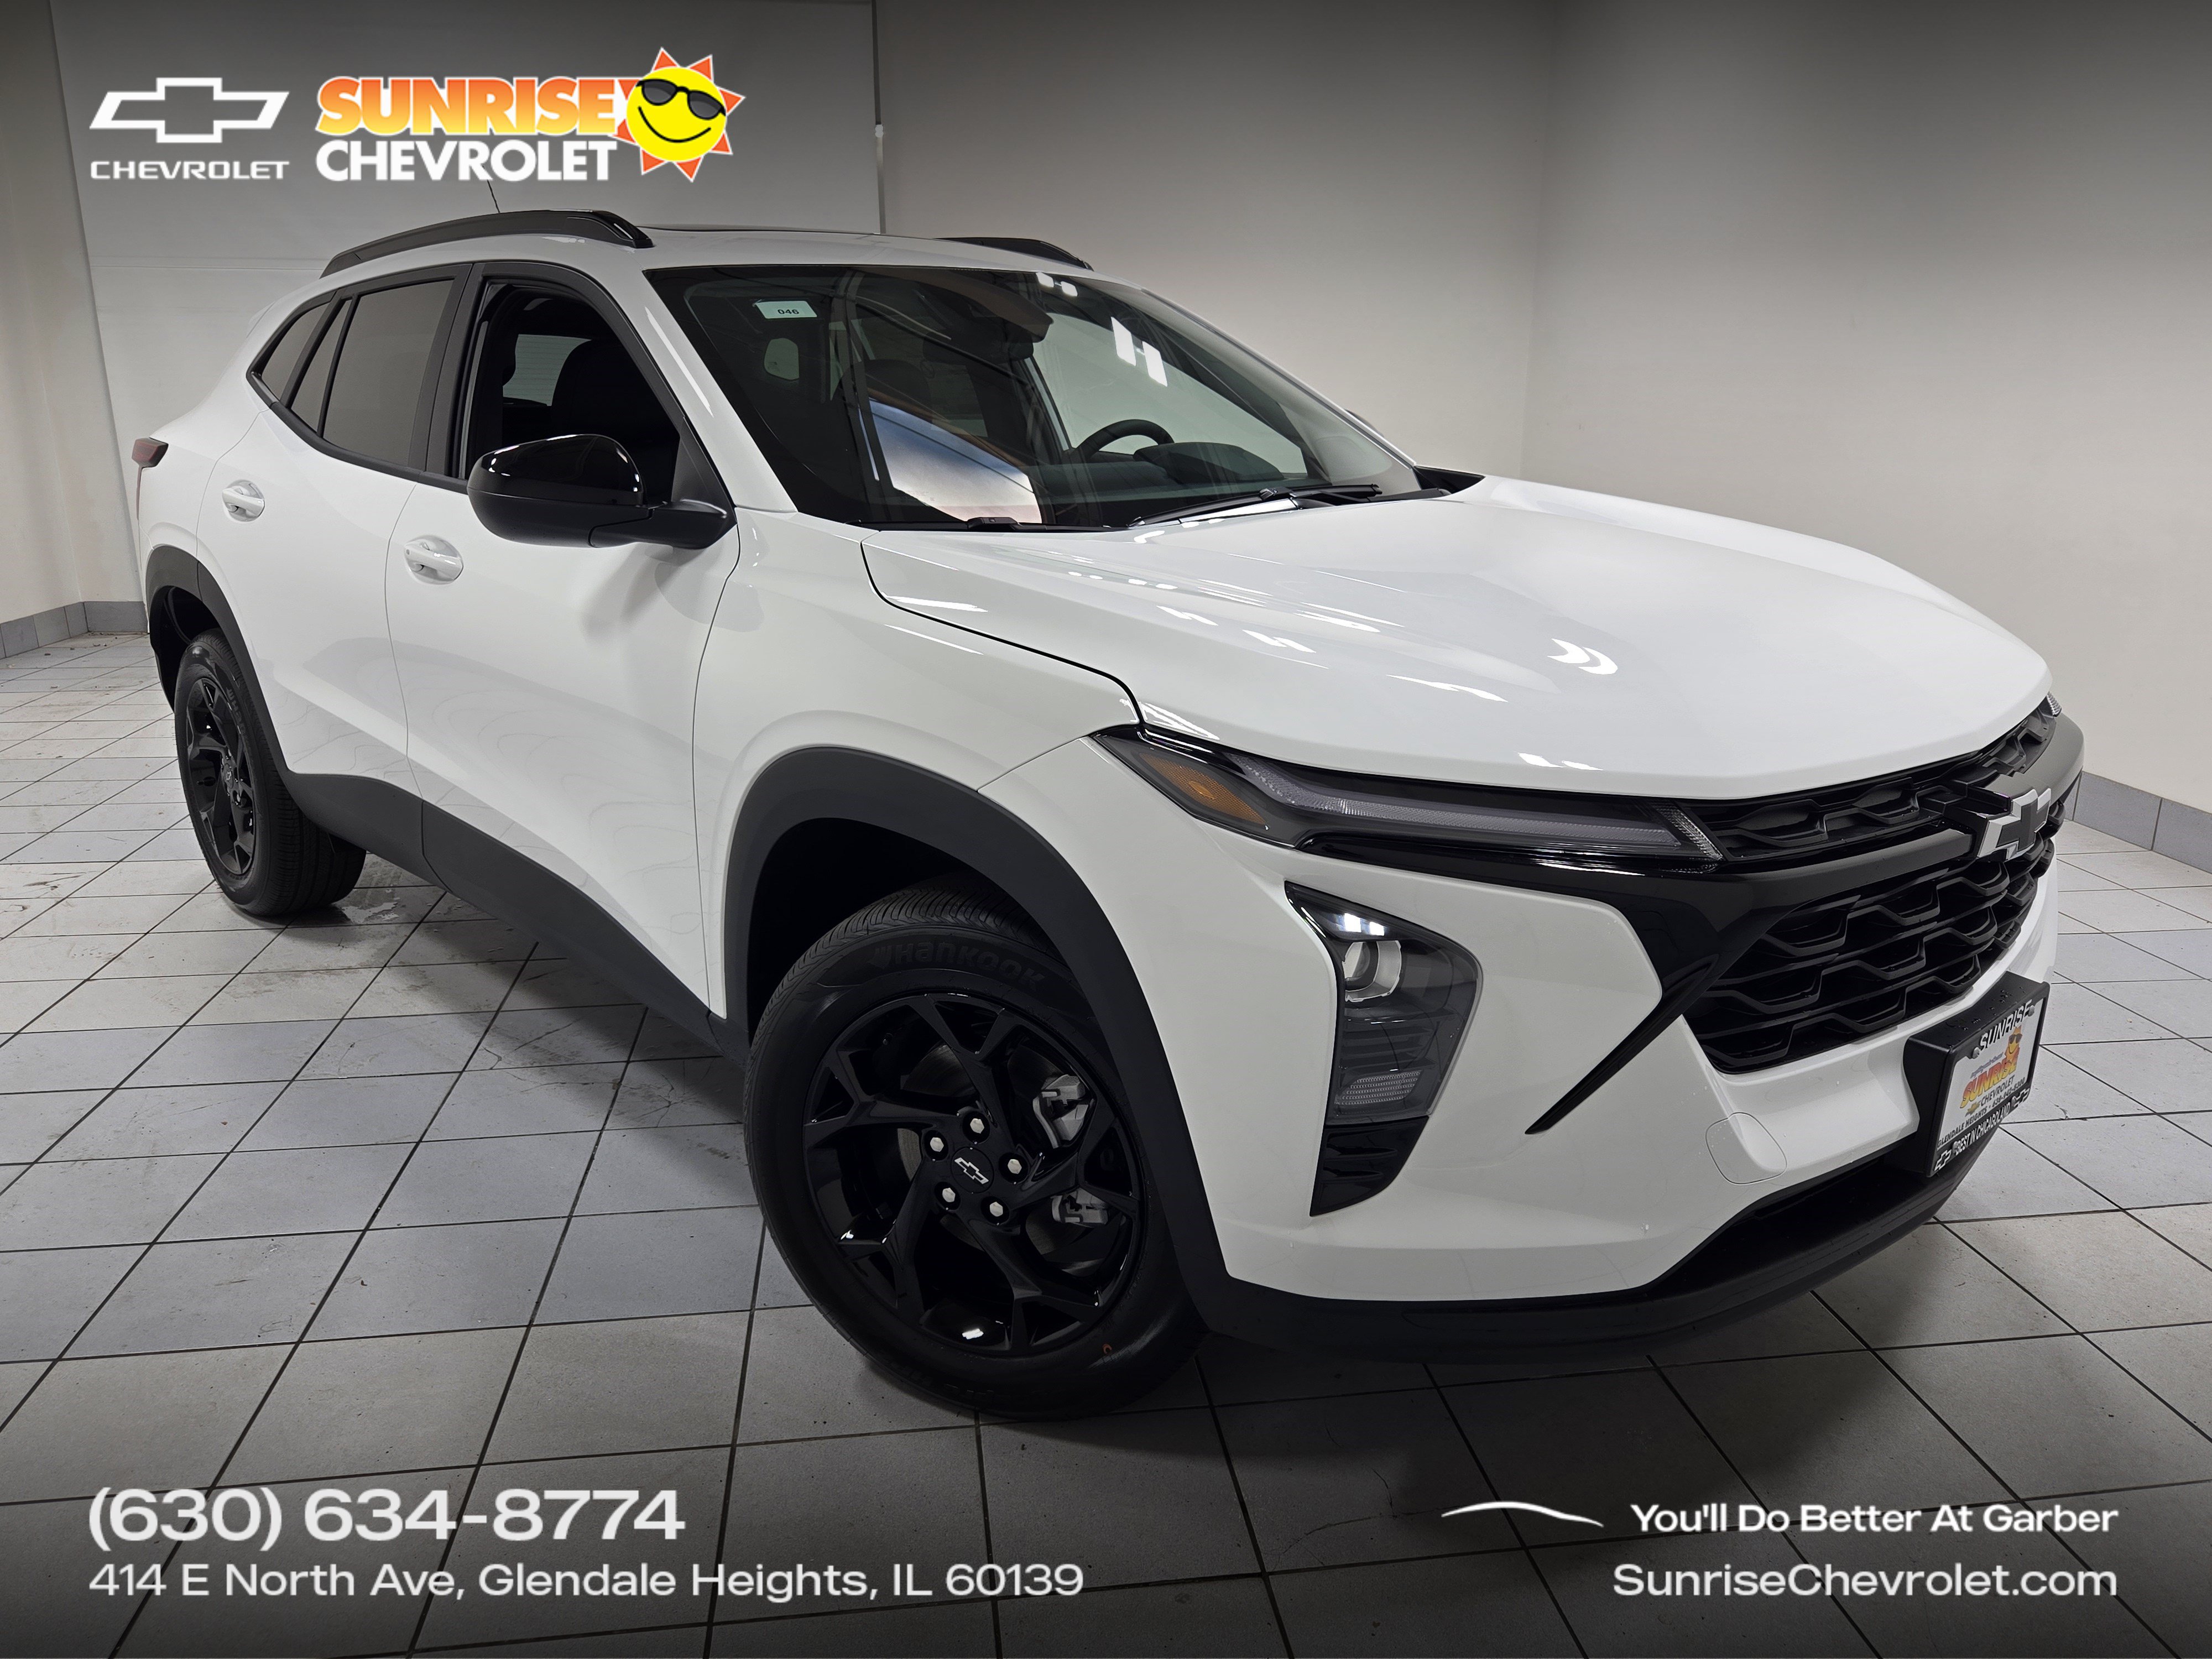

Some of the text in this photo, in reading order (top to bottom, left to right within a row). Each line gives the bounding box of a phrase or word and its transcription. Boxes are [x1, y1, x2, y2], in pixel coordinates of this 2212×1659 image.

[1980, 999, 2032, 1051] SUNRISE
[1960, 1056, 2017, 1109] SUNRISE
[1981, 1074, 2015, 1107] CHEVROLET
[1938, 1122, 1965, 1147] GLENDALE
[1965, 1107, 1988, 1129] HEIGHTS
[1955, 1132, 1970, 1156] BEST
[1976, 1102, 2011, 1140] CHICAGOLAND
